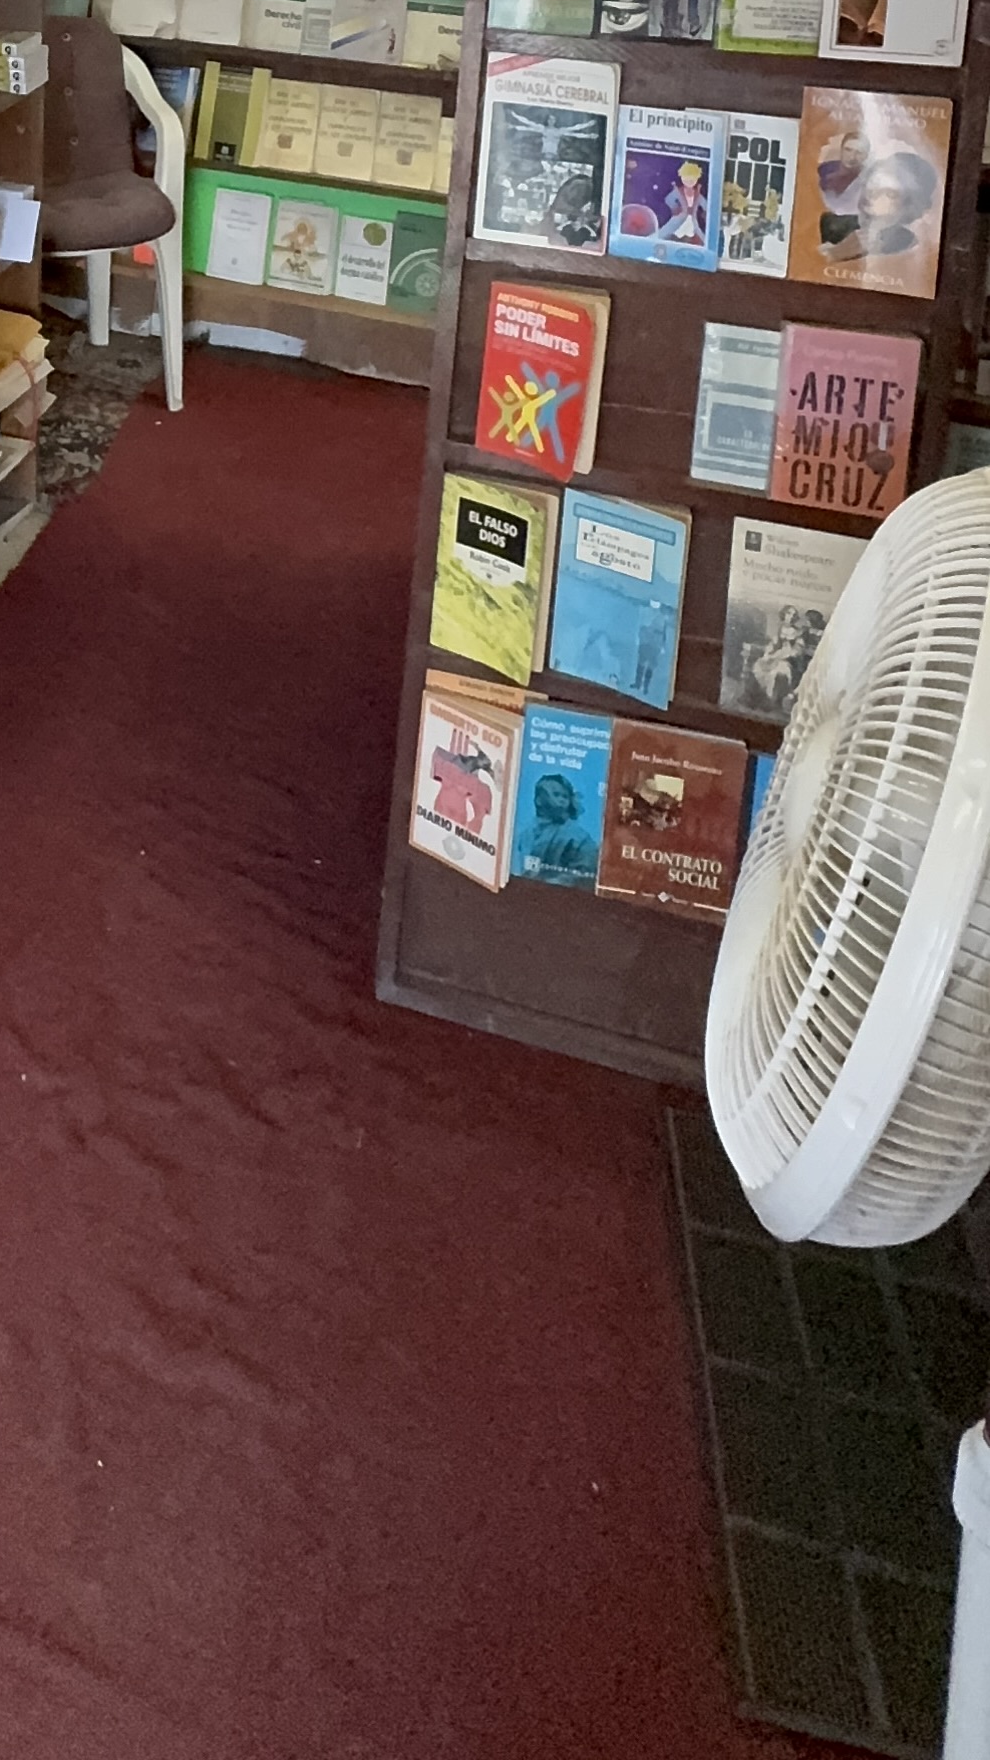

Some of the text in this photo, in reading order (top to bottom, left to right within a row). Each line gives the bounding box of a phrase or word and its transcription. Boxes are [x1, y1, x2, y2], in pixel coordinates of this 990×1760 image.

[494, 78, 610, 105] GIMNASIA CEREBRAL
[629, 108, 713, 134] El principito
[822, 265, 905, 287] CLEMENCIA
[494, 320, 520, 338] SIN
[495, 303, 547, 330] PODER
[796, 371, 902, 422] ARTE
[787, 457, 891, 512] CRUZ
[468, 510, 519, 538] EL FALSO
[478, 528, 507, 549] DIOS
[469, 550, 491, 565] Robin
[482, 726, 503, 749] ECO
[540, 742, 588, 759] disfrutar
[559, 757, 583, 771] vida
[416, 804, 452, 833] DIARIO
[621, 844, 723, 875] EL CONTRATO
[667, 867, 721, 891] SOCIAL
